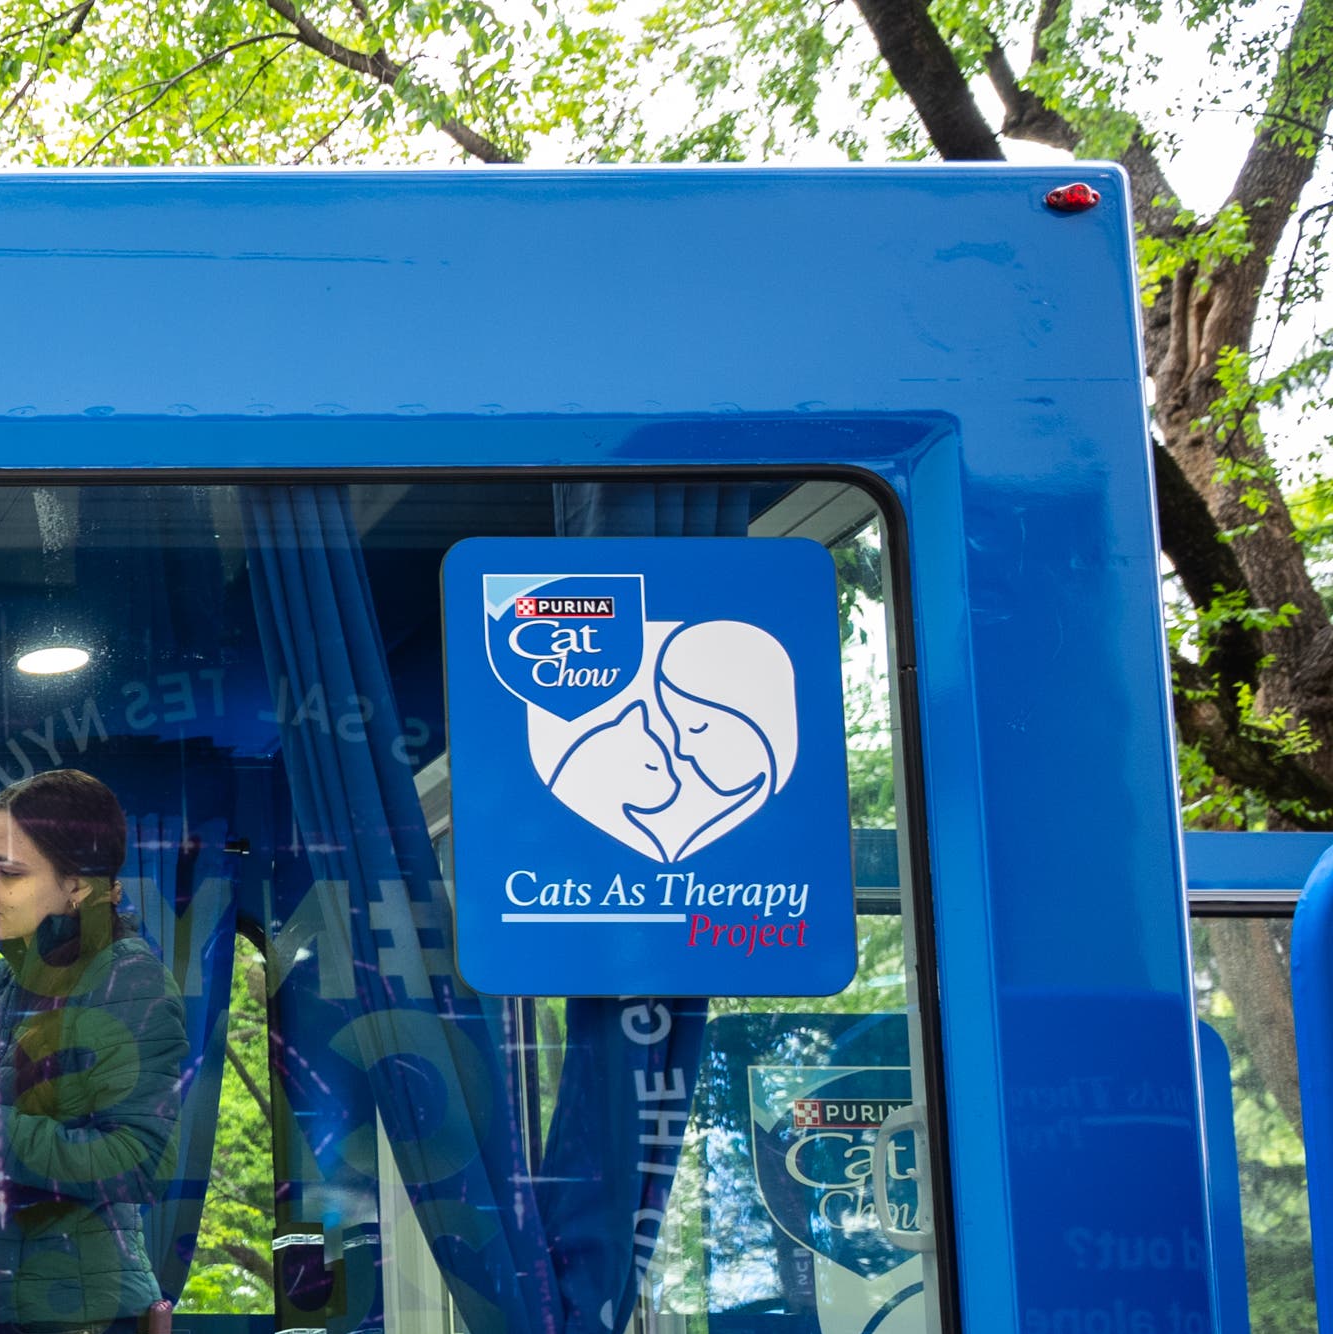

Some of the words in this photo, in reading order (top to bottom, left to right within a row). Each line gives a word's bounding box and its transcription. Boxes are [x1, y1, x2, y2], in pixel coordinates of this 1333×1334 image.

[538, 600, 610, 613] PURINA
[509, 620, 602, 660] Cat
[532, 655, 618, 688] Chow
[505, 871, 592, 906] Cats
[601, 874, 645, 906] As
[656, 873, 809, 917] Therapy
[688, 914, 808, 955] Project
[785, 1132, 916, 1189] Cat
